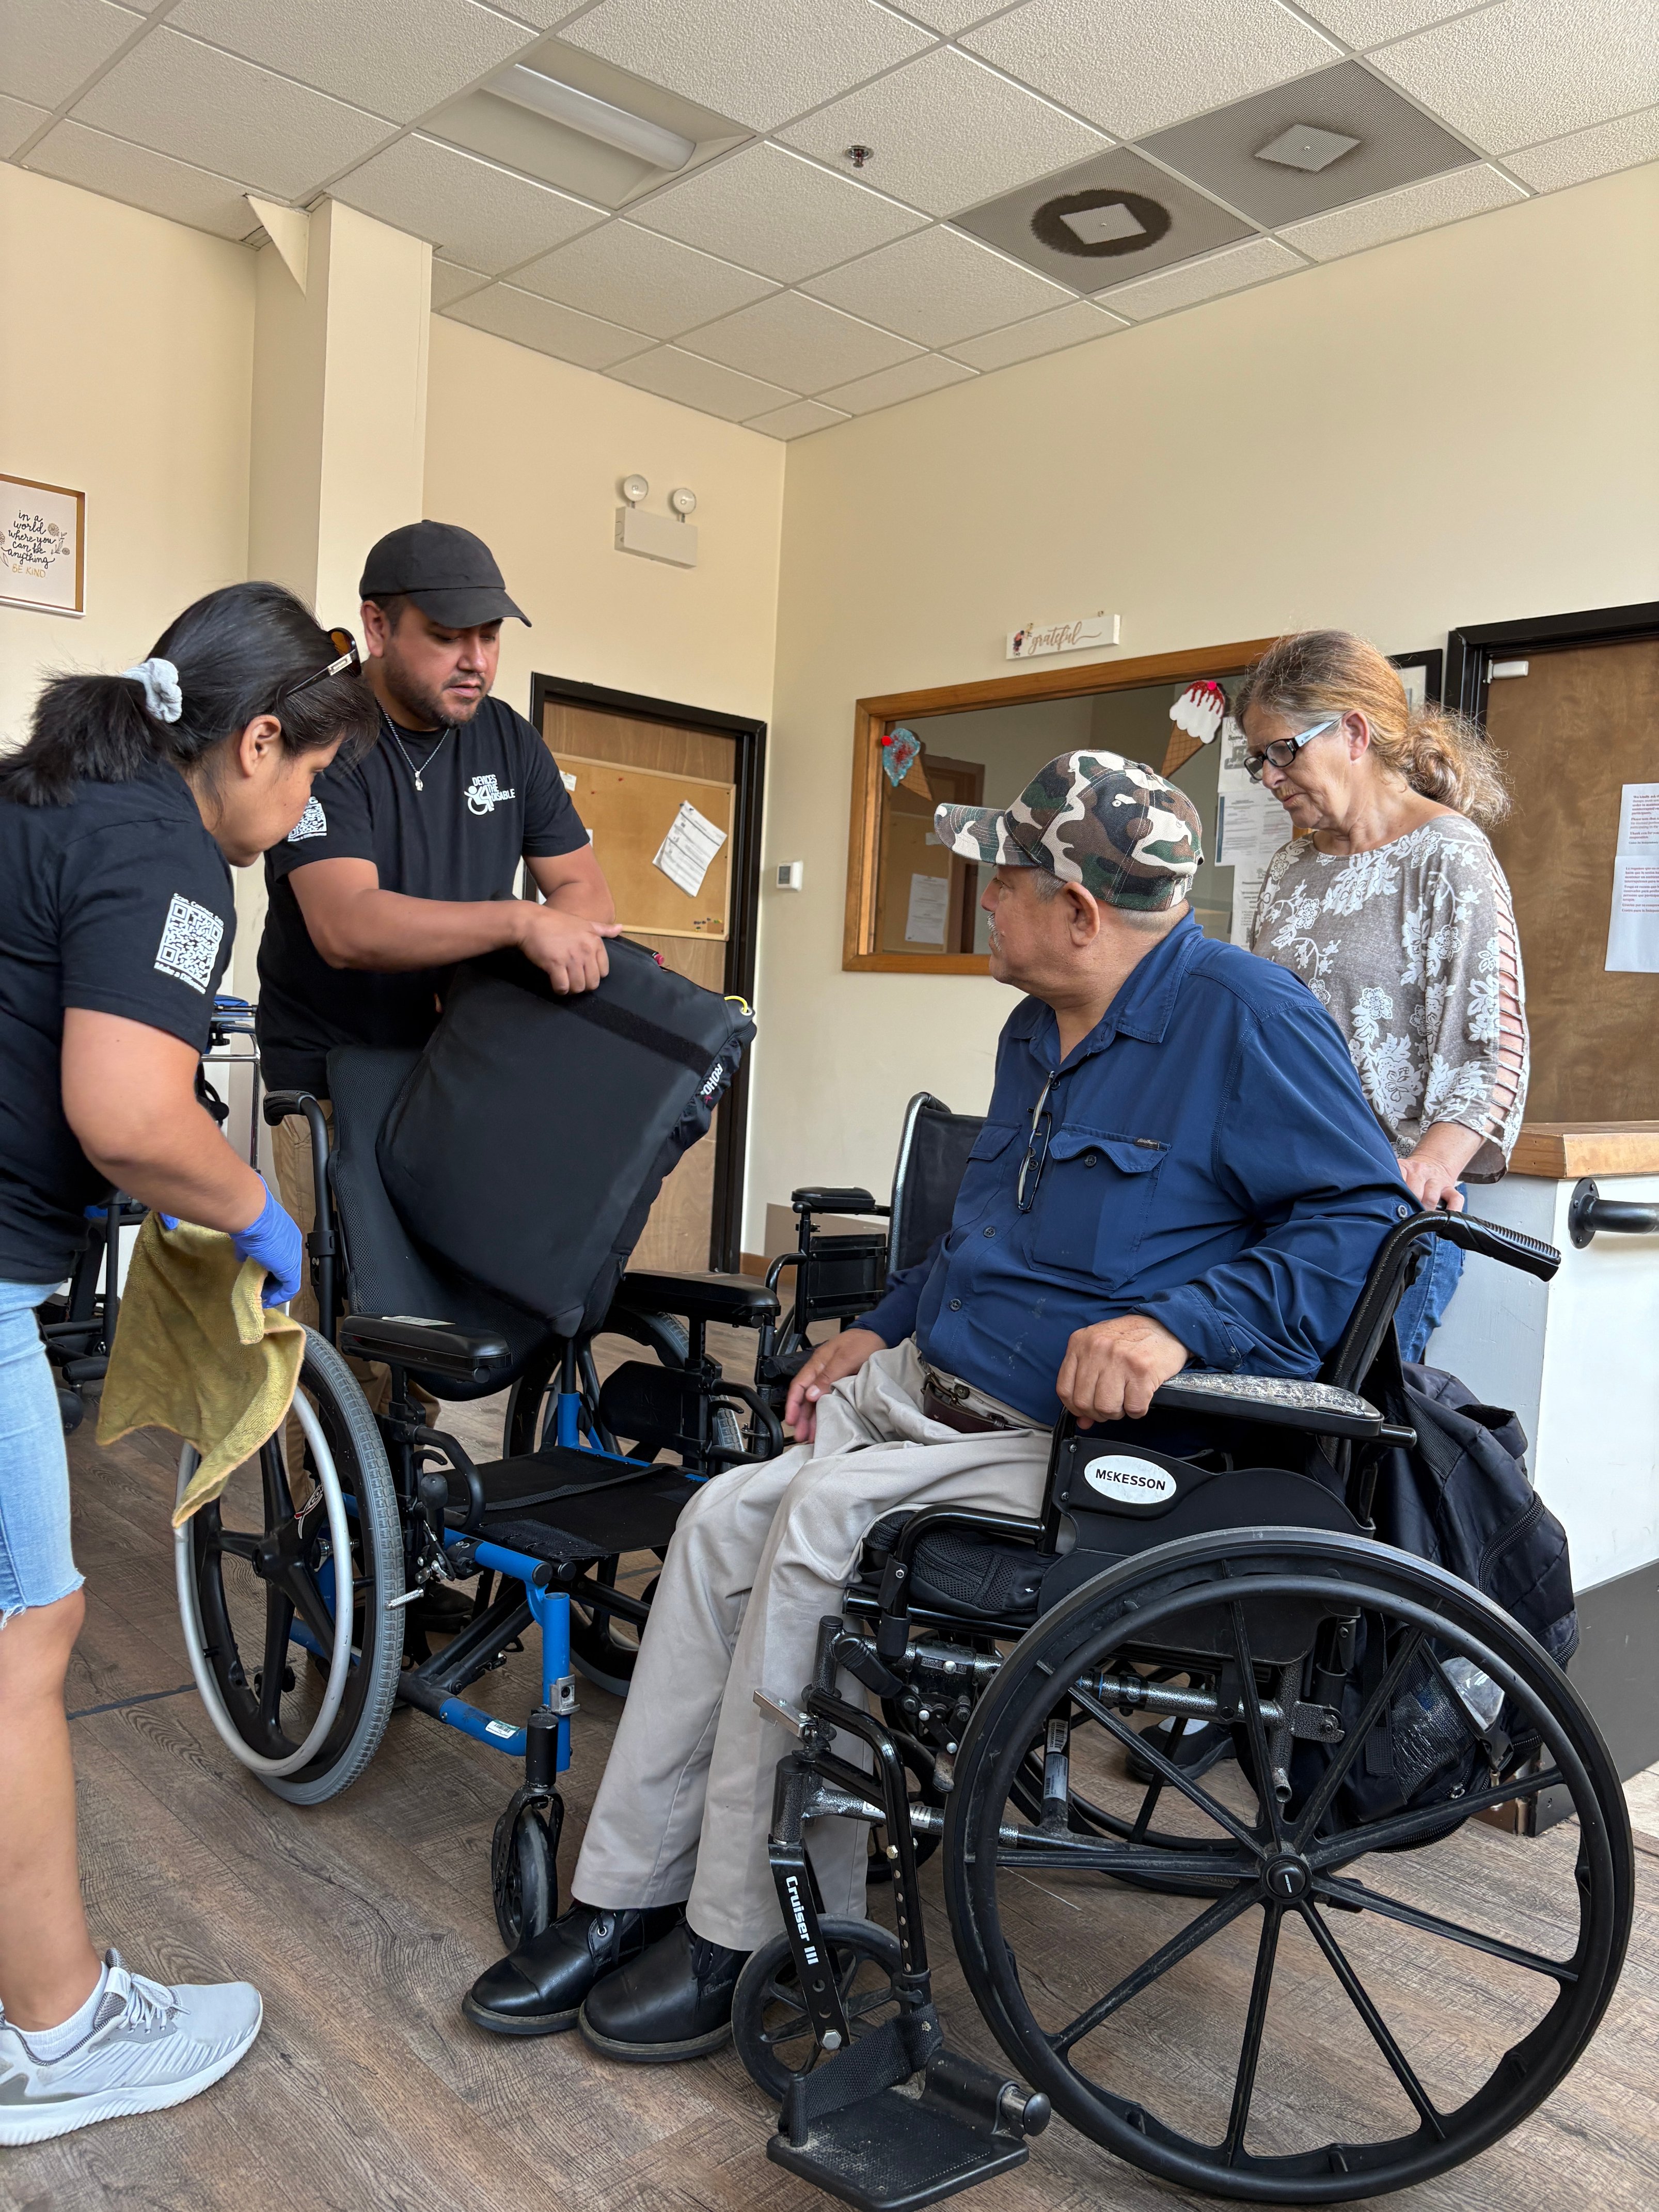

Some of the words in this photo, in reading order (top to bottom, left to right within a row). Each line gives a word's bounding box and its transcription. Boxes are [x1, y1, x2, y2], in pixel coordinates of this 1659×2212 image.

[19, 510, 30, 521] in
[13, 520, 46, 534] world
[8, 530, 36, 541] where
[36, 537, 56, 549] you
[12, 541, 31, 552] can
[33, 543, 46, 554] be
[6, 548, 55, 570] anything
[12, 563, 23, 573] BE
[26, 566, 46, 578] KIND
[1028, 621, 1102, 655] grateful
[472, 774, 497, 786] DEVICES
[487, 783, 499, 793] THE
[702, 1063, 723, 1095] ROHO
[786, 1876, 810, 1941] Cruiser
[804, 1946, 819, 1965] III
